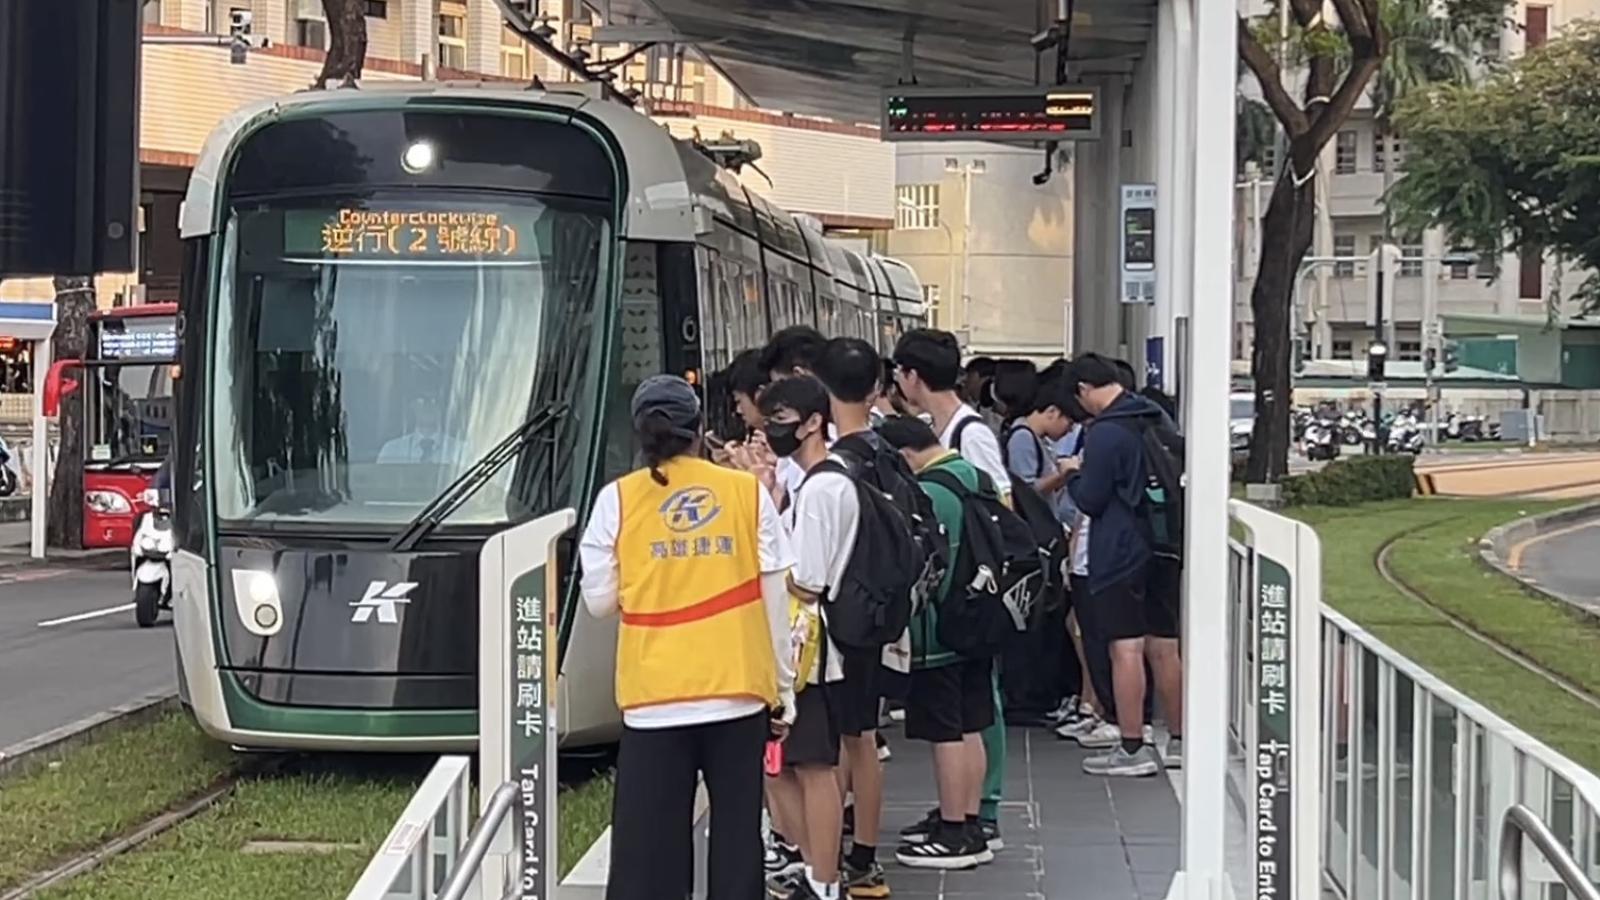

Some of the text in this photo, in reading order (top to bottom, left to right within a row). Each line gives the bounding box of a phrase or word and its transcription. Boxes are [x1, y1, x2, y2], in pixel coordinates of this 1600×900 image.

[339, 208, 498, 226] Counterclockwise
[516, 596, 542, 737] 進站請刷卡
[1260, 584, 1286, 715] 進站請刷卡
[1256, 739, 1277, 778] Tap
[1258, 783, 1278, 831] Card
[1258, 835, 1277, 857] to
[523, 867, 539, 890] to
